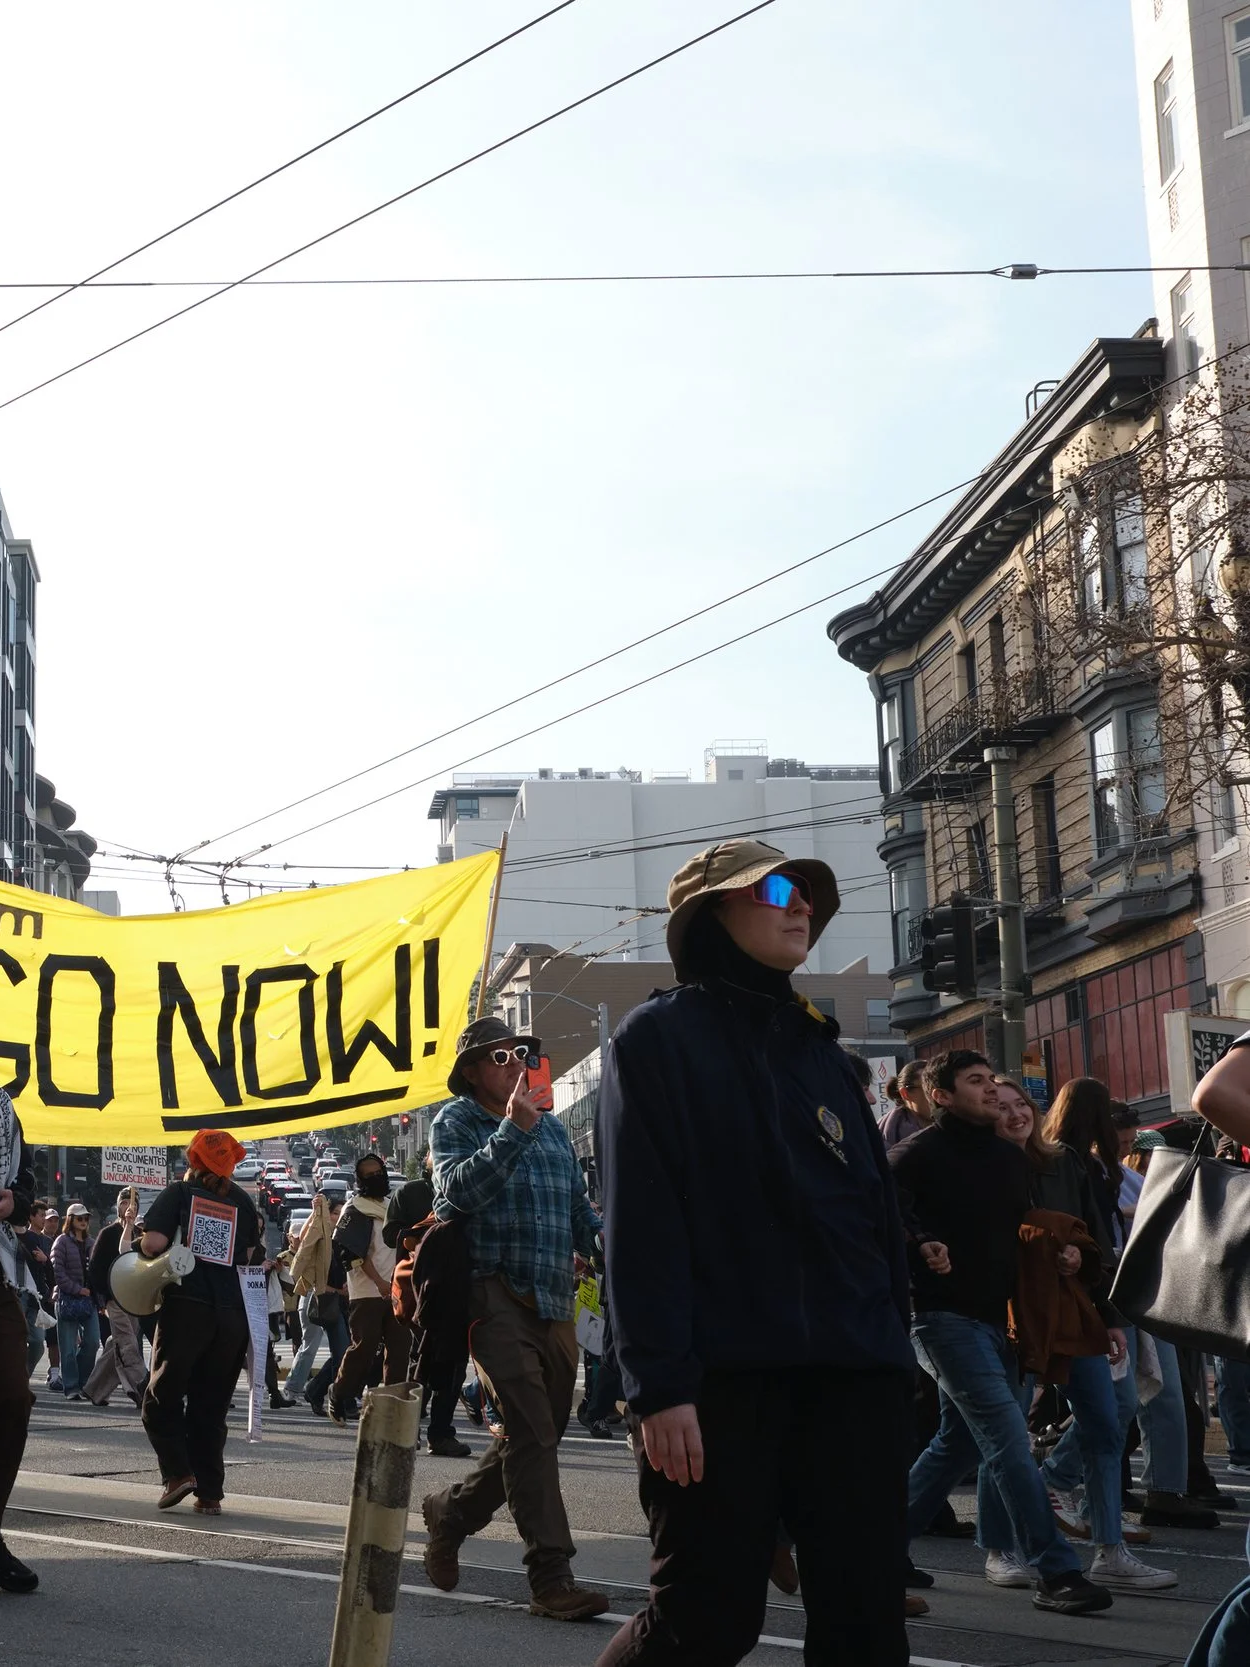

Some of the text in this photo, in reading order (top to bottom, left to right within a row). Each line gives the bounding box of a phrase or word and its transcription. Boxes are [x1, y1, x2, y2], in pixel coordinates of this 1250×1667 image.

[156, 938, 440, 1109] NOW!
[878, 1082, 889, 1116] ESP
[105, 1151, 167, 1167] UNDOCUMENTED
[131, 1146, 147, 1154] NOT
[150, 1147, 167, 1157] THE
[103, 1172, 167, 1187] UNCONSCIONABLE
